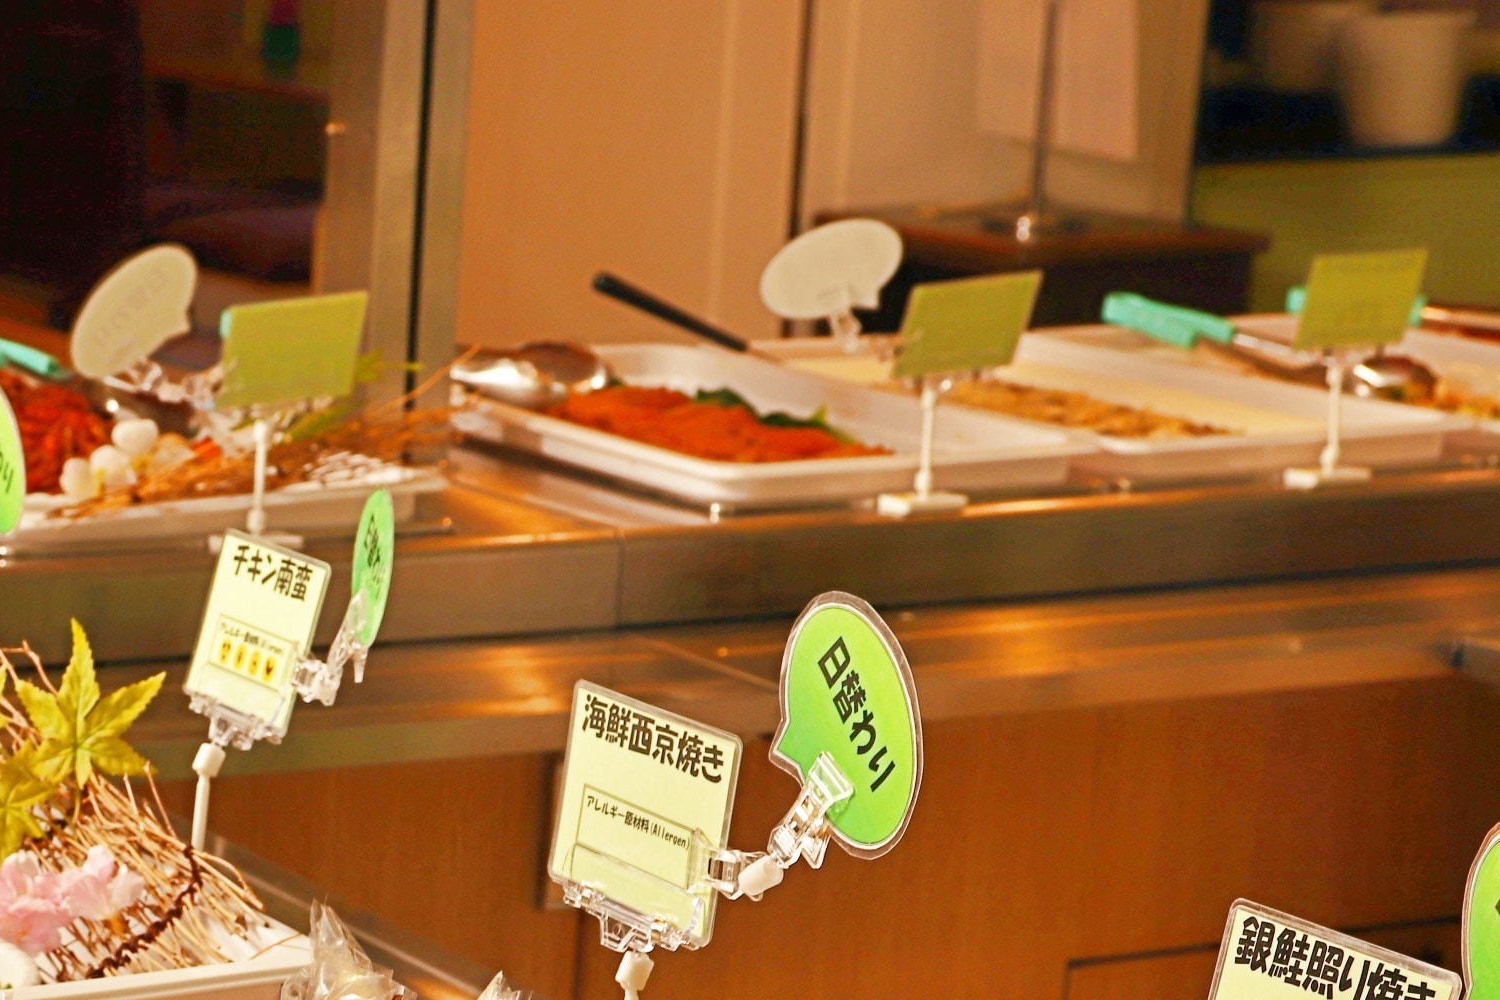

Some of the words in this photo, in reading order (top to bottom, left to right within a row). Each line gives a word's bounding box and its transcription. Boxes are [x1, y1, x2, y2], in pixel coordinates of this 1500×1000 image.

[232, 544, 314, 603] チキン南蛮
[581, 692, 725, 786] 海鮮西京焼き
[816, 635, 897, 793] 日替わり
